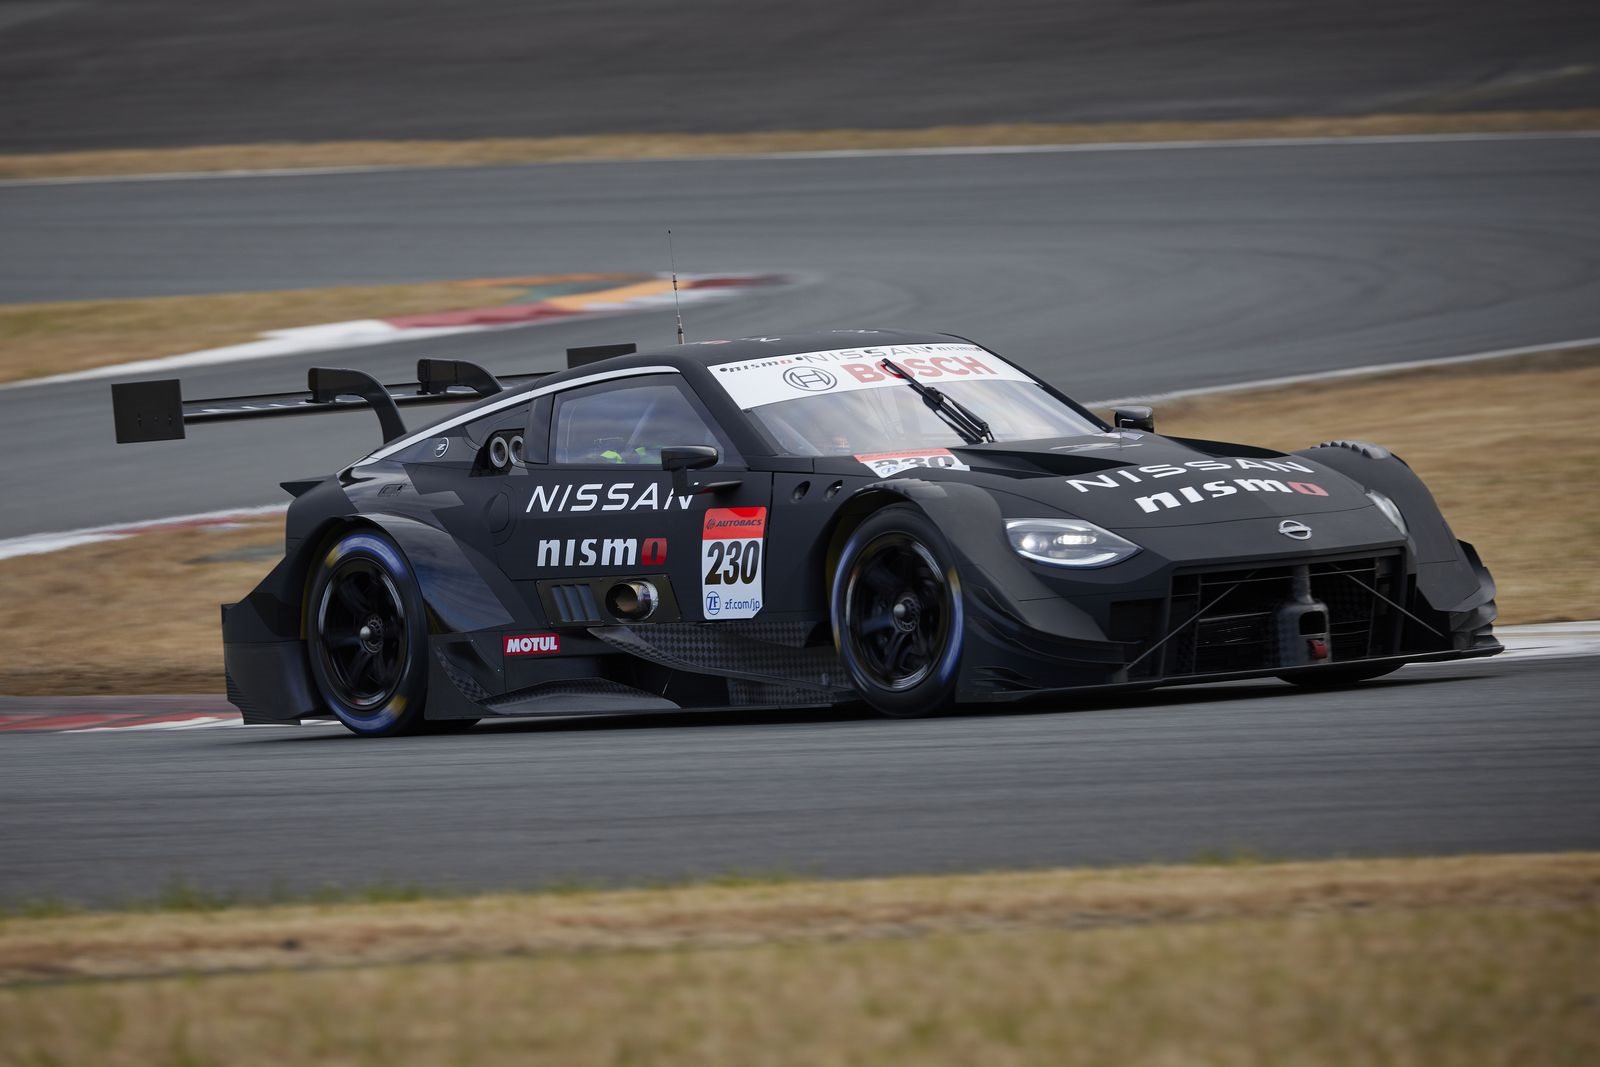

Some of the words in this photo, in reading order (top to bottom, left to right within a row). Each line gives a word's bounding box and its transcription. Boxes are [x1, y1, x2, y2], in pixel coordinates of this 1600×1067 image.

[804, 345, 933, 364] NISSAN
[840, 355, 999, 383] BOSCH
[1065, 458, 1315, 493] NISSAN
[1134, 478, 1330, 514] nismo
[716, 519, 763, 527] AUTOBACS
[537, 537, 668, 567] nismo
[704, 540, 760, 585] 230
[725, 598, 760, 612] zf.com/jp
[506, 636, 558, 653] MOTUL
